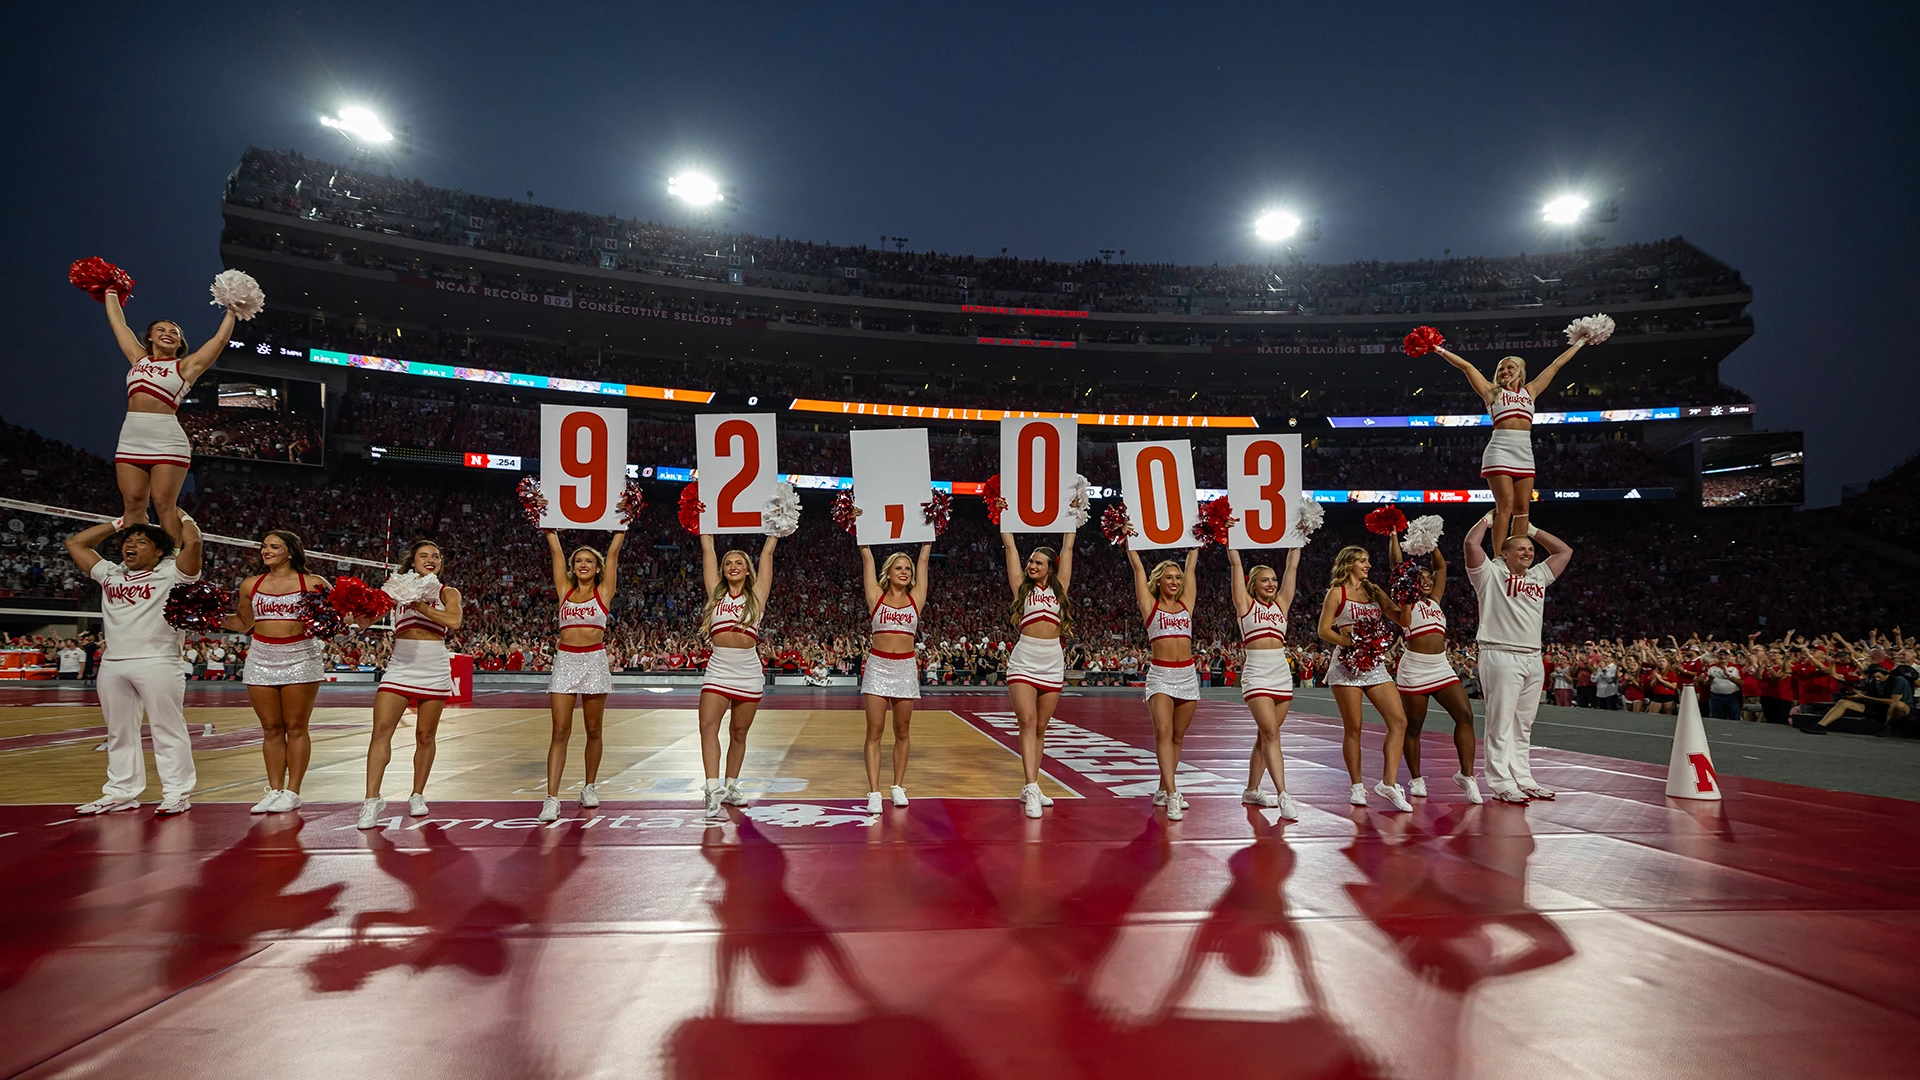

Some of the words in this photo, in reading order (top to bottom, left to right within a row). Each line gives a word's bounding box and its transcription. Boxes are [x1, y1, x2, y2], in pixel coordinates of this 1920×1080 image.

[435, 280, 476, 294] NCAA
[484, 287, 538, 303] RECORD
[578, 300, 668, 318] CONSECUTIVE
[674, 312, 733, 326] SELLOUTS
[961, 304, 1010, 315] NATIONAL
[1257, 345, 1301, 354] NATION
[1306, 345, 1355, 354] LEADING
[1460, 343, 1481, 351] ALL
[1486, 340, 1559, 350] AMERICANS
[128, 362, 173, 378] Huskers
[664, 389, 675, 400] N
[843, 402, 983, 420] VOLLEYBALL
[1098, 414, 1209, 427] NEBRASKA
[471, 455, 482, 466] N
[496, 459, 516, 467] .254
[559, 411, 608, 524] 9
[714, 419, 761, 528] 2
[1017, 421, 1060, 527] 0
[1136, 446, 1184, 545] 0
[1244, 440, 1286, 546] 3
[103, 575, 156, 605] Huskers
[255, 597, 297, 616] Huskers
[561, 602, 597, 621] Huskers
[879, 606, 914, 626] Huskers
[1157, 612, 1190, 631] Huskers
[1252, 606, 1284, 627] Huskers
[332, 814, 728, 831] Ameritas
